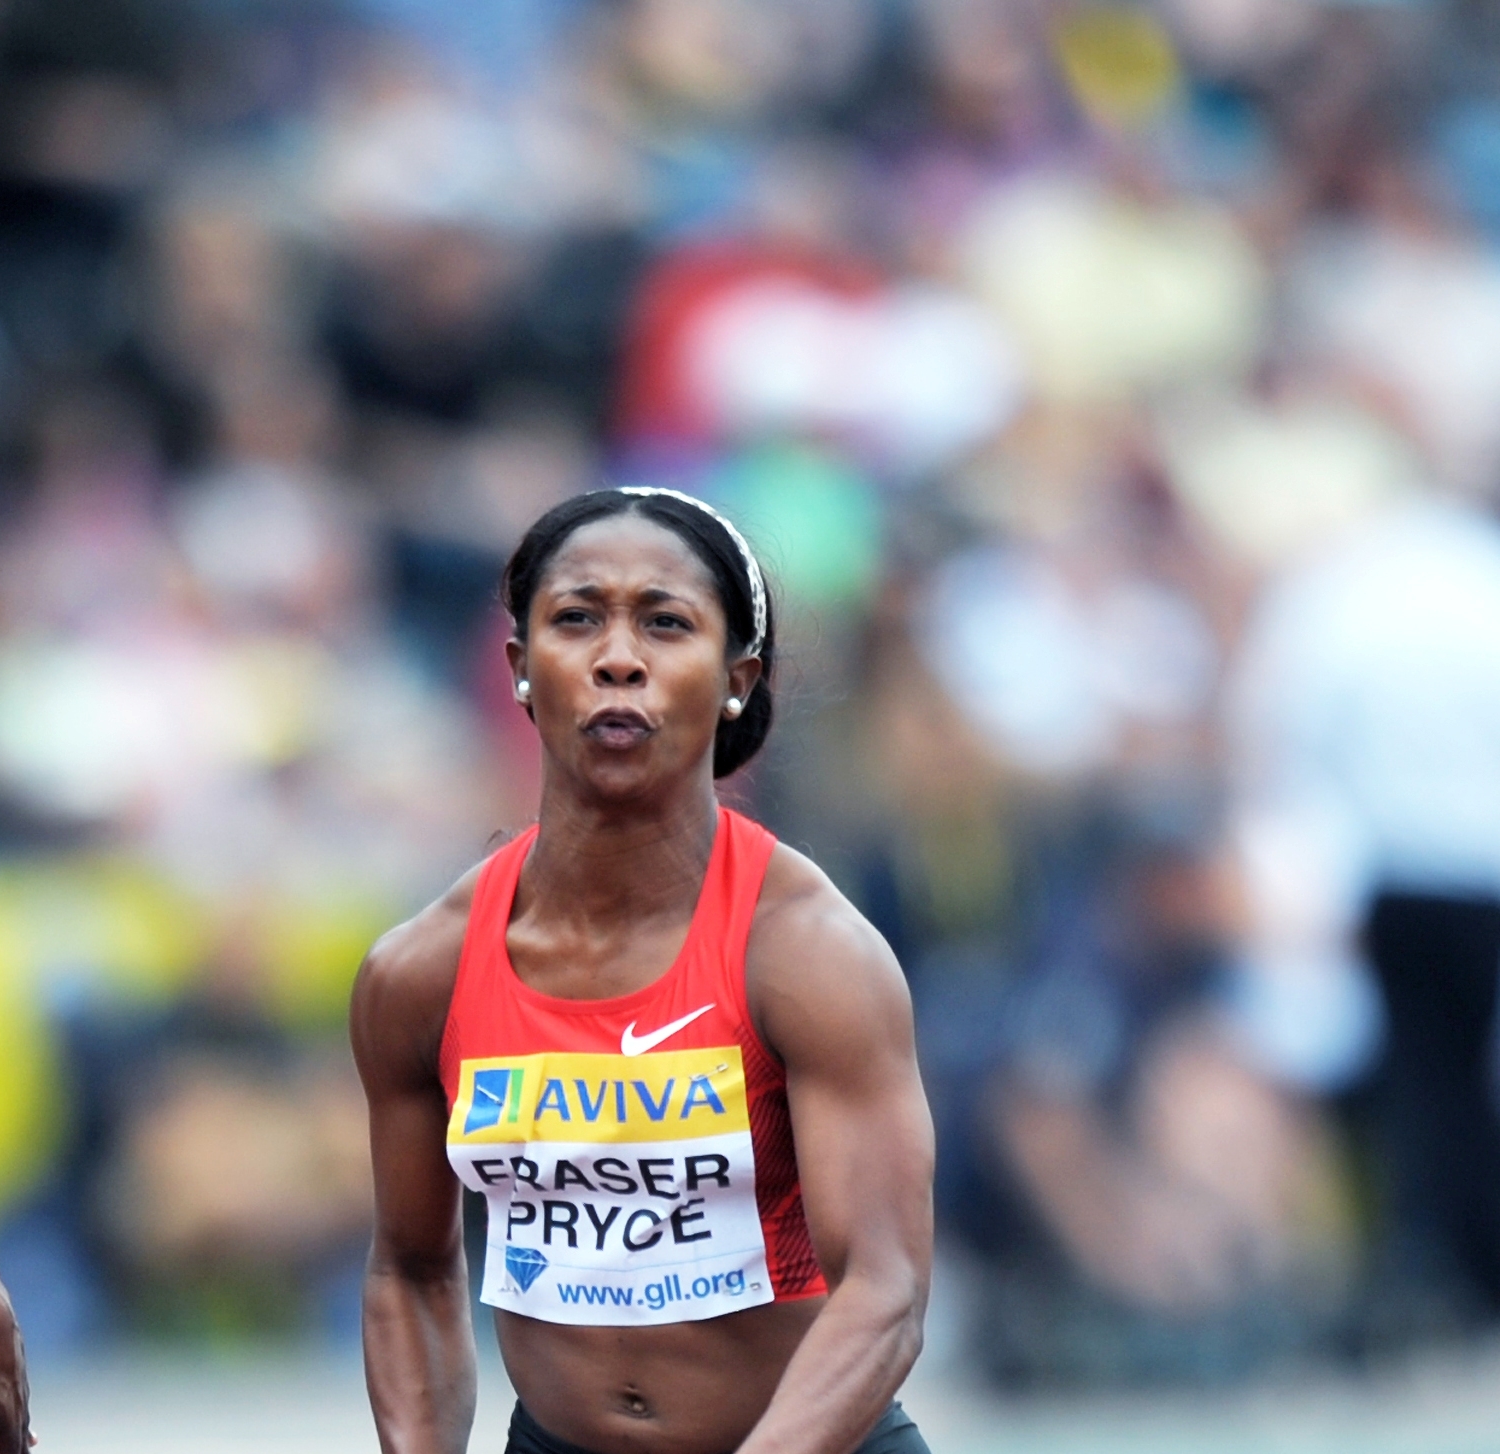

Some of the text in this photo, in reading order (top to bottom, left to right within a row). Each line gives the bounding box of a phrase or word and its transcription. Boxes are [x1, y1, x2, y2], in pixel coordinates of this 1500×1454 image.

[534, 1076, 726, 1123] AVIVA
[471, 1154, 731, 1199] FRASER
[506, 1197, 712, 1252] PRYCE
[557, 1266, 746, 1310] www.gll.org
